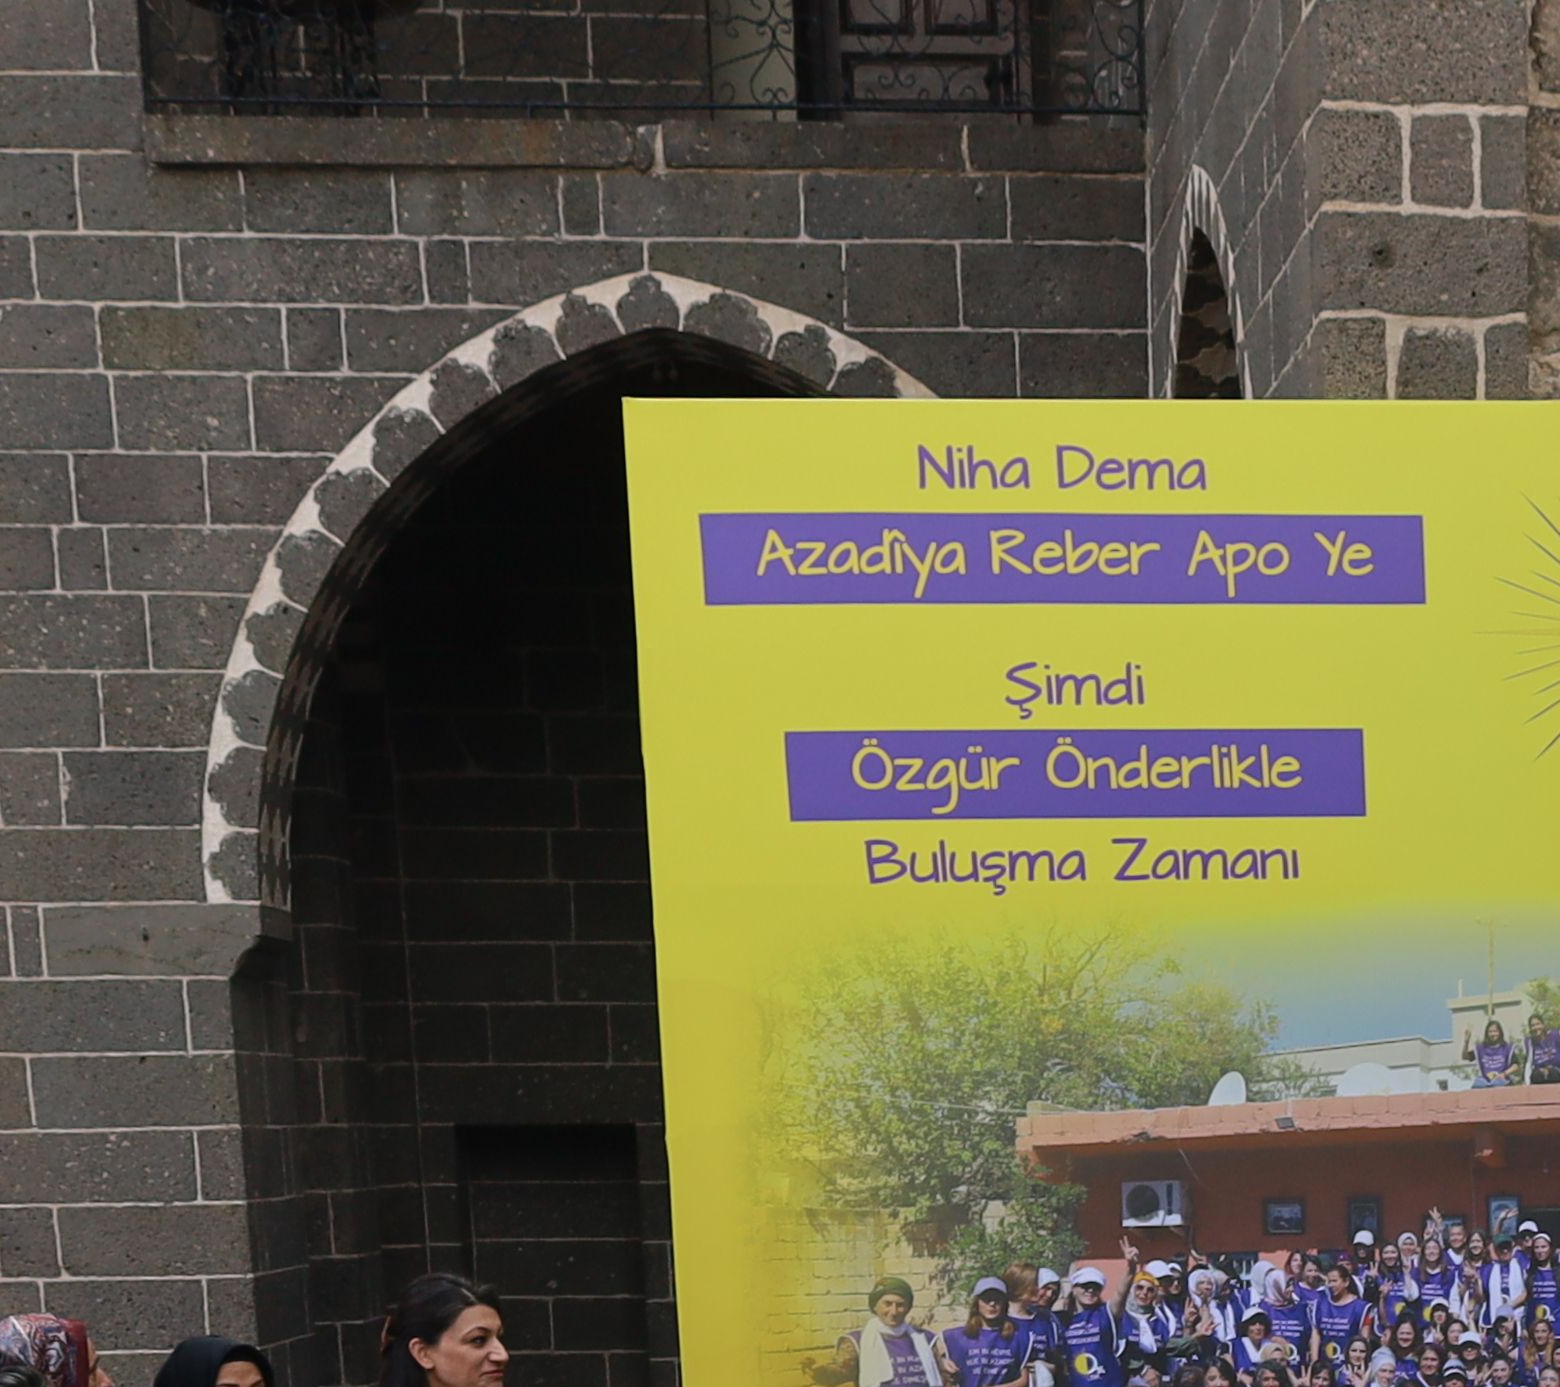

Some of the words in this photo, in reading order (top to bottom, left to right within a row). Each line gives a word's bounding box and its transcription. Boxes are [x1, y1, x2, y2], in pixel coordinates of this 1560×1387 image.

[917, 445, 1030, 490] Niha
[1057, 445, 1208, 491] Dema
[990, 528, 1162, 577] Reber
[1187, 530, 1292, 599] Apo
[1314, 530, 1375, 577] Ye
[1006, 661, 1146, 720] Şimdi
[851, 737, 1022, 815] Özgür
[1045, 736, 1304, 790] Önderlikle
[866, 838, 1087, 896] Buluşma
[1112, 837, 1300, 882] Zamanı
